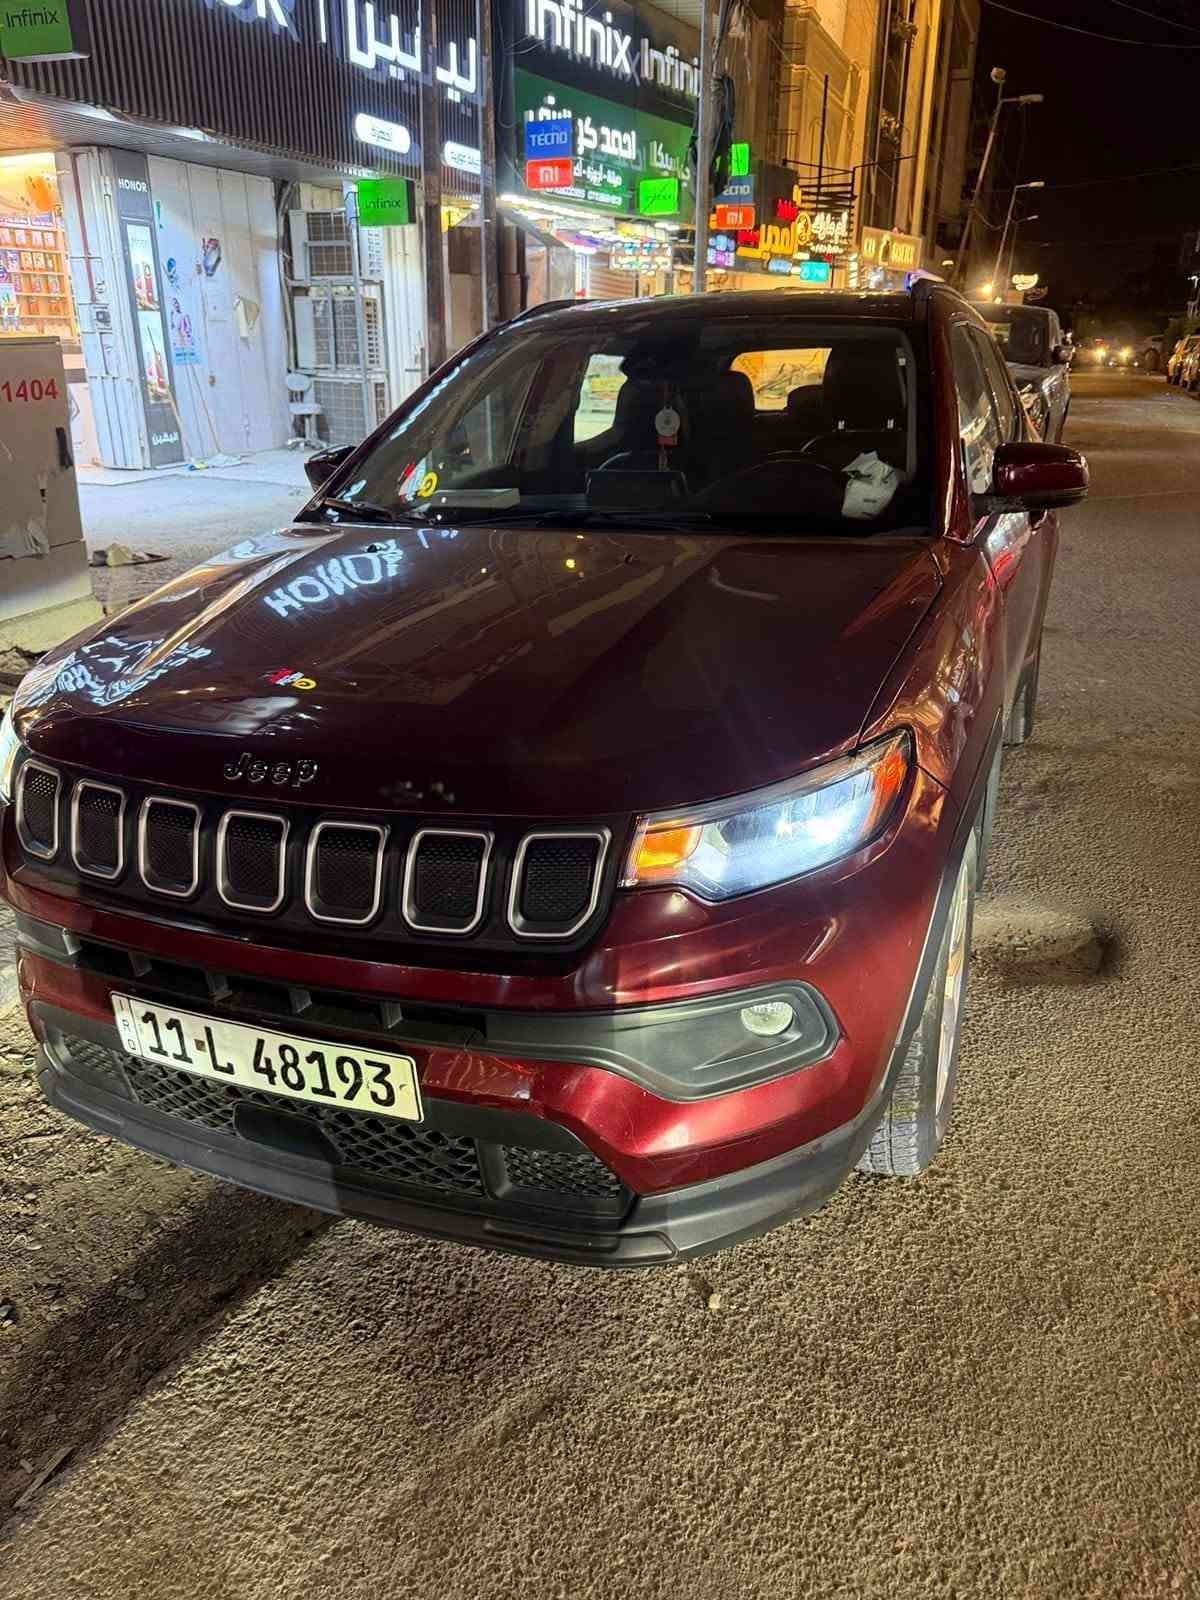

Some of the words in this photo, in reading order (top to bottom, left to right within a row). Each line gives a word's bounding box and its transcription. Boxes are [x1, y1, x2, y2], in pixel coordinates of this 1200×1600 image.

[6, 7, 60, 29] Infinix
[525, 0, 632, 74] Infinix
[640, 38, 701, 97] Infini
[529, 131, 568, 148] TECNO
[118, 177, 148, 193] HONOR
[1, 378, 59, 402] 1404
[223, 752, 320, 788] Jeep
[253, 1038, 396, 1107] 48193
